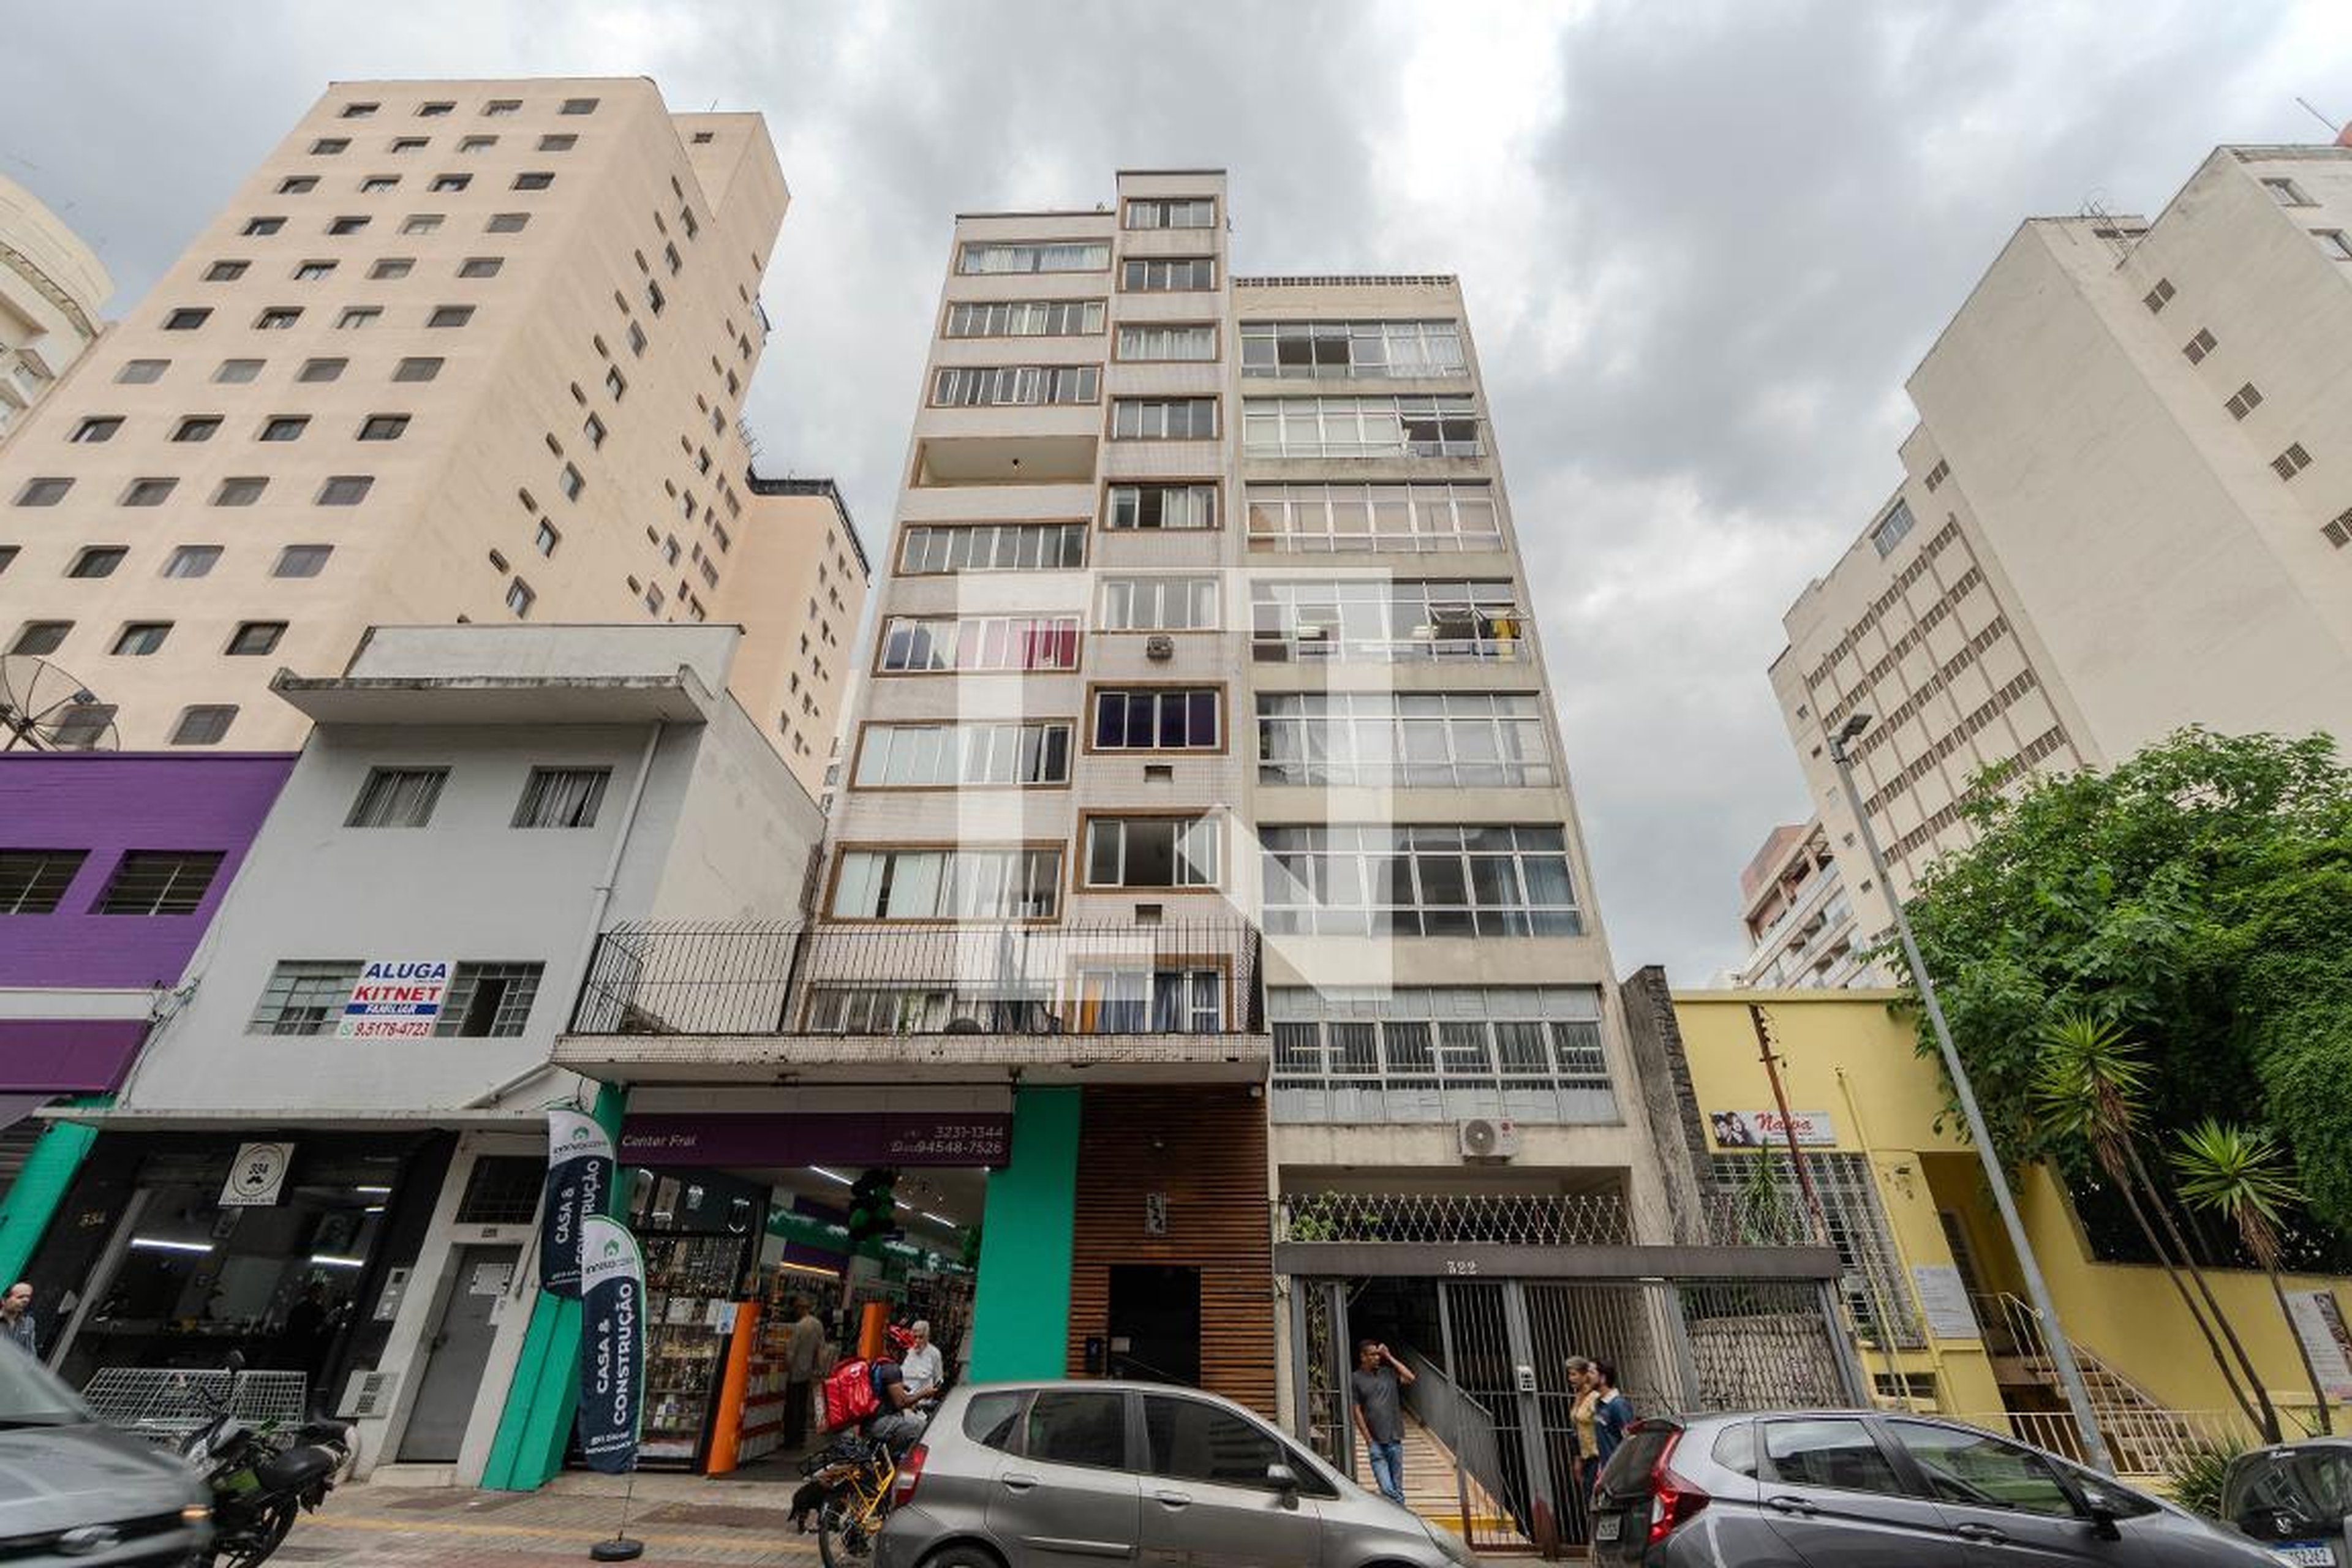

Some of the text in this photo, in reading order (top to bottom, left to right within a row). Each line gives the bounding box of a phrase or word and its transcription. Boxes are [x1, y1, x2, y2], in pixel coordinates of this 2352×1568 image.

[366, 963, 446, 978] ALUGA
[354, 986, 442, 1001] KITNET
[1754, 1112, 1814, 1131] Nava
[555, 1202, 573, 1243] CASA
[575, 1161, 600, 1265] CONTRUÇÃO
[1447, 1261, 1477, 1275] 322
[597, 1338, 610, 1393] CASA
[614, 1283, 636, 1425] CONSTRUÇÃO
